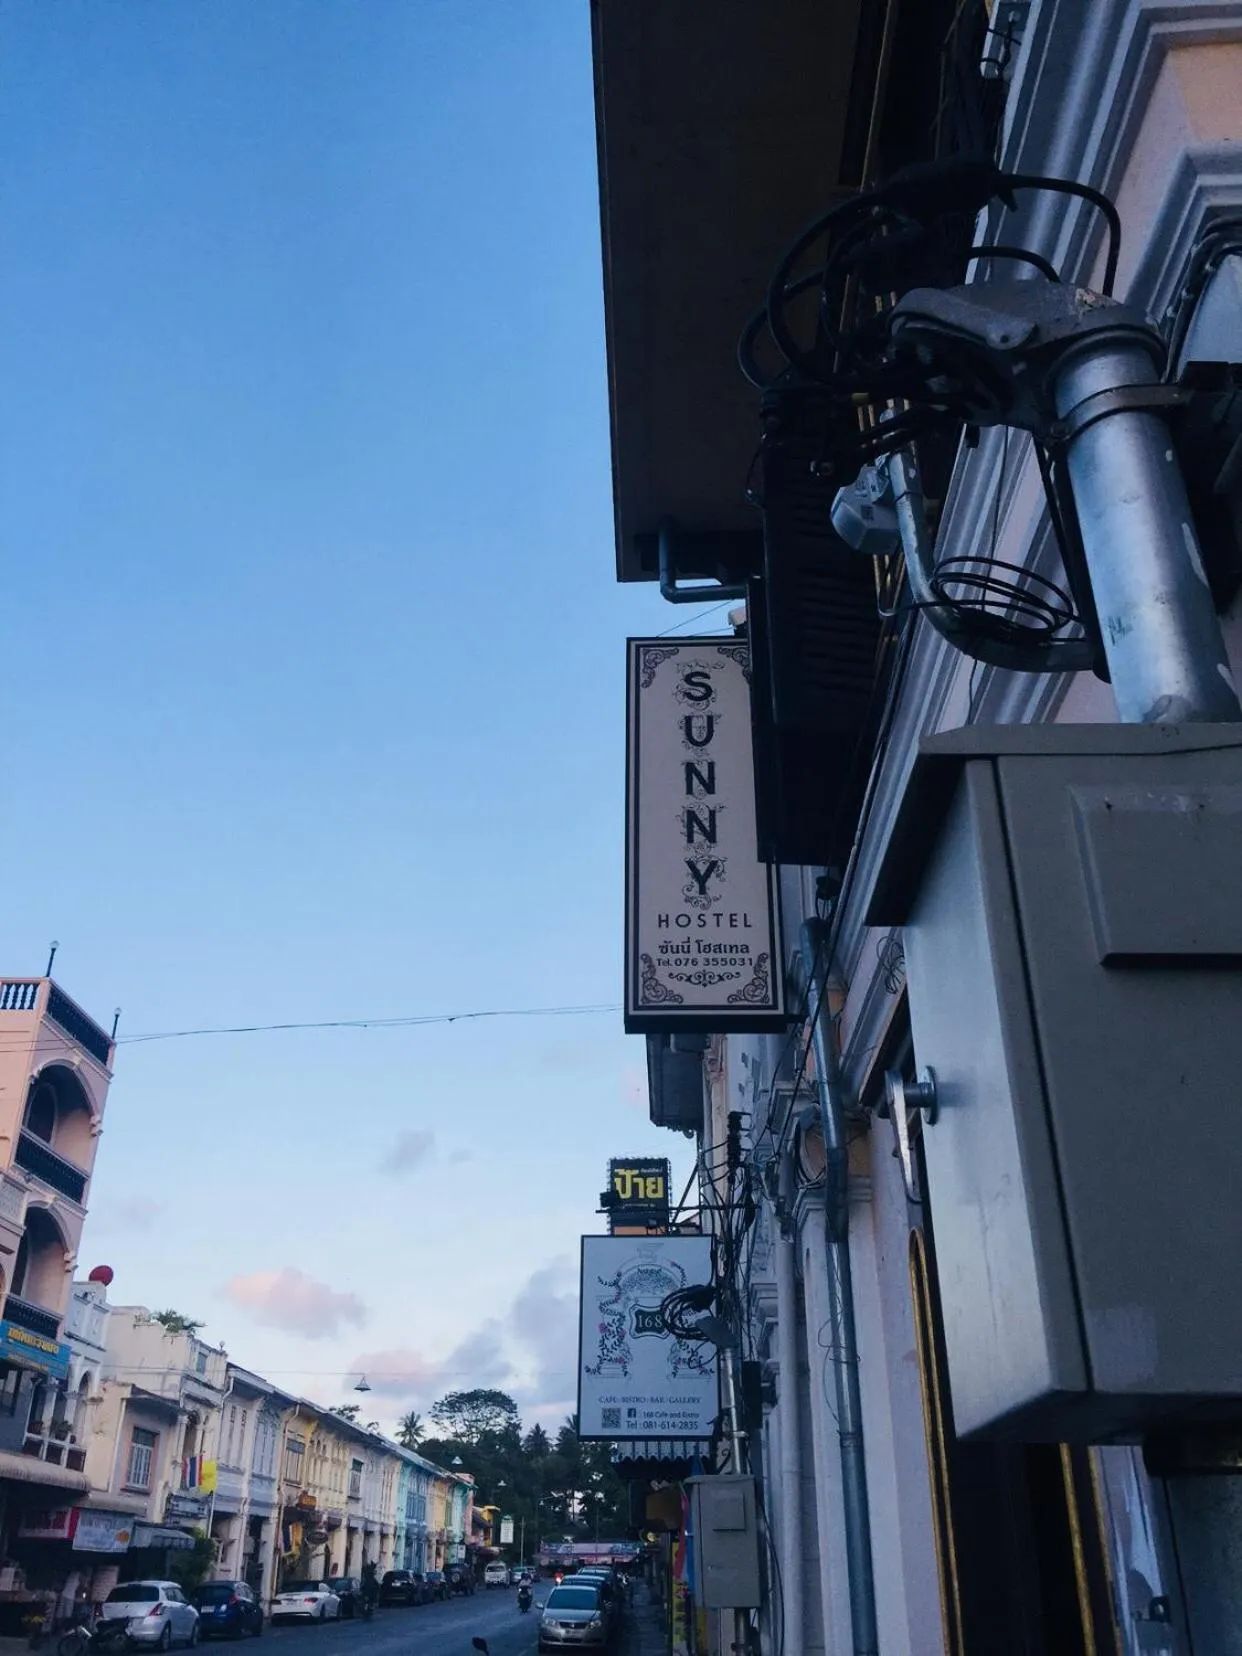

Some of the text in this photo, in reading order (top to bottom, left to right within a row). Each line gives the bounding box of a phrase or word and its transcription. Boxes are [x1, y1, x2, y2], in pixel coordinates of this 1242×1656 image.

[684, 671, 718, 895] SUNNY
[658, 913, 752, 928] HOSTEL
[703, 957, 753, 967] 355031
[638, 1314, 663, 1328] 168
